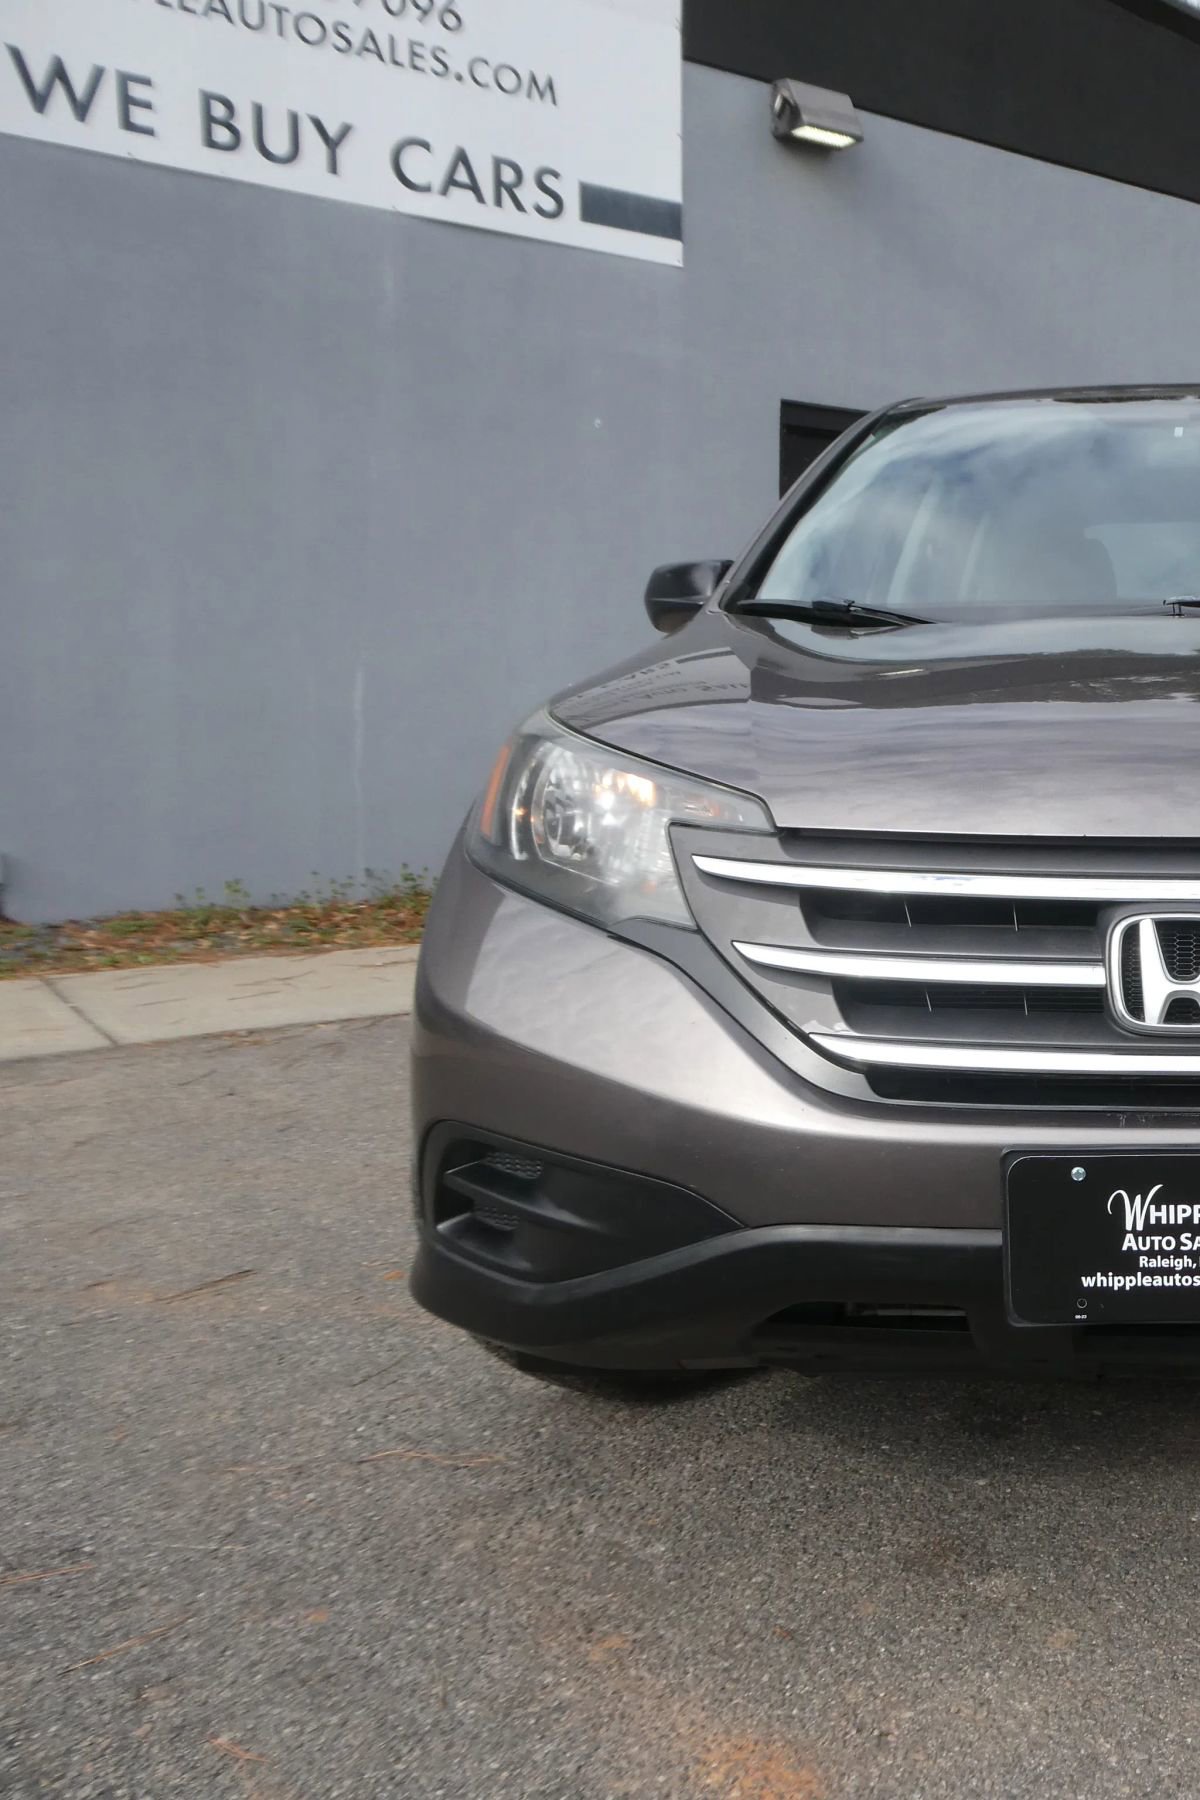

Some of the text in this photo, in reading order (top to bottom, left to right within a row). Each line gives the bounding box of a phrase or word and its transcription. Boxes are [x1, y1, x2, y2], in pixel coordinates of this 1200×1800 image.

[353, 0, 462, 31] 096
[153, 0, 557, 106] AUTOSALES.COM
[6, 42, 564, 219] WE BUY CARS
[1122, 1233, 1176, 1251] AUTO
[1139, 1255, 1197, 1270] Raleigh,
